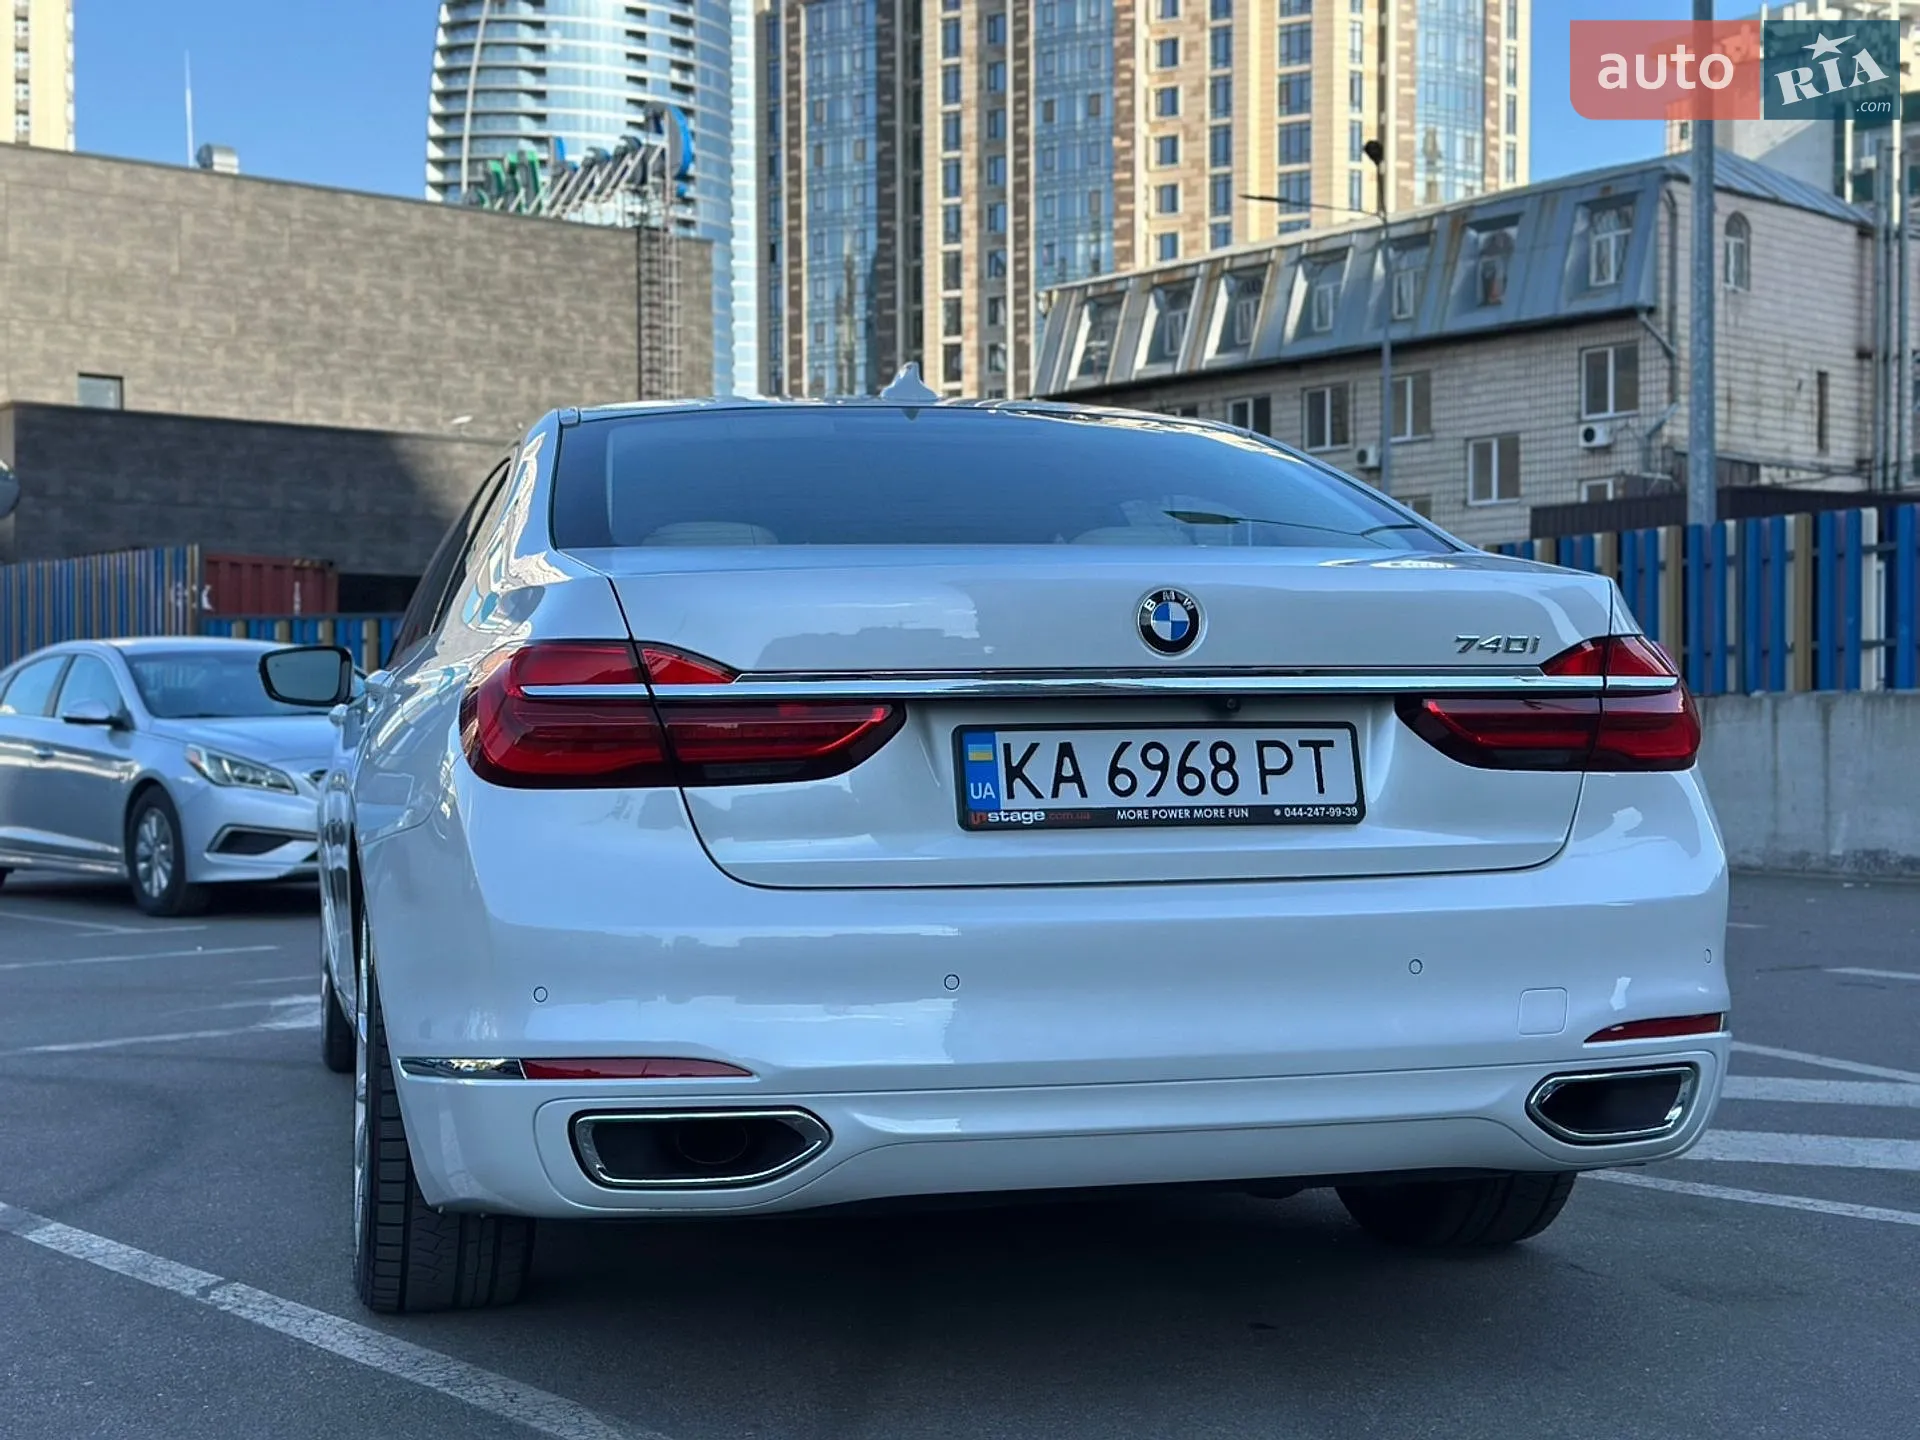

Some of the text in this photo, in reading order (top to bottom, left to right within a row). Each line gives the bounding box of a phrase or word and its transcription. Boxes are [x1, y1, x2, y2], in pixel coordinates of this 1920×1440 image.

[1144, 590, 1195, 612] BMW
[1003, 740, 1334, 800] KA 6968 PT
[970, 782, 996, 799] UA
[1117, 808, 1249, 820] MORE POWER MORE FUN
[1284, 807, 1358, 817] 044-247-99-39
